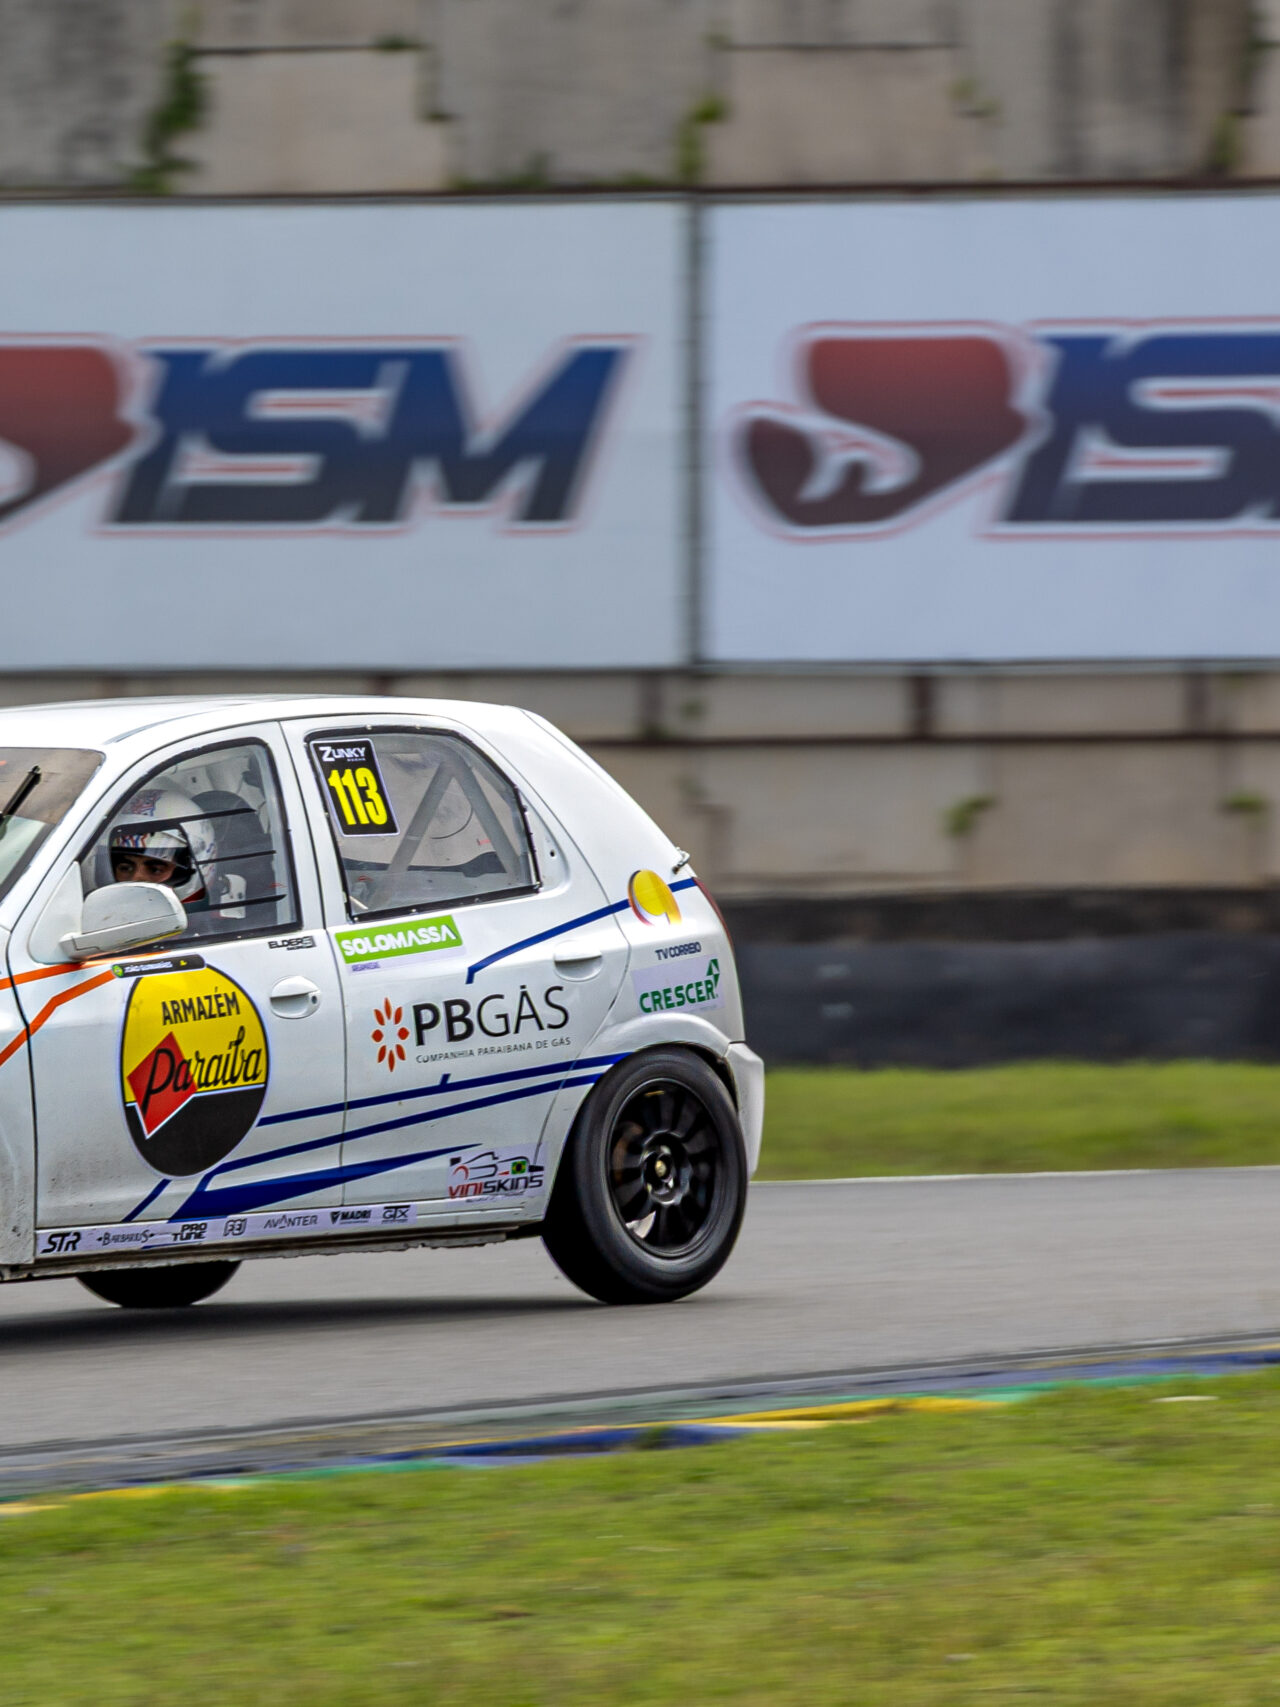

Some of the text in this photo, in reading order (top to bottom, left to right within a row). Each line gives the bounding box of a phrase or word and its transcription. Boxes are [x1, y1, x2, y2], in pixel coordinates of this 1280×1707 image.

[327, 767, 388, 825] 113
[340, 924, 458, 956] SOLOMASSA
[655, 948, 669, 960] TV
[161, 986, 241, 1026] ARMAZÉM
[639, 979, 716, 1013] CRESCER
[411, 984, 570, 1047] PBGÁS
[415, 1049, 475, 1064] COMPANHIA
[477, 1041, 533, 1056] PARAIBANA
[535, 1039, 548, 1050] DE
[172, 1231, 206, 1242] TUNE
[181, 1222, 208, 1233] PRO
[41, 1231, 82, 1254] STR
